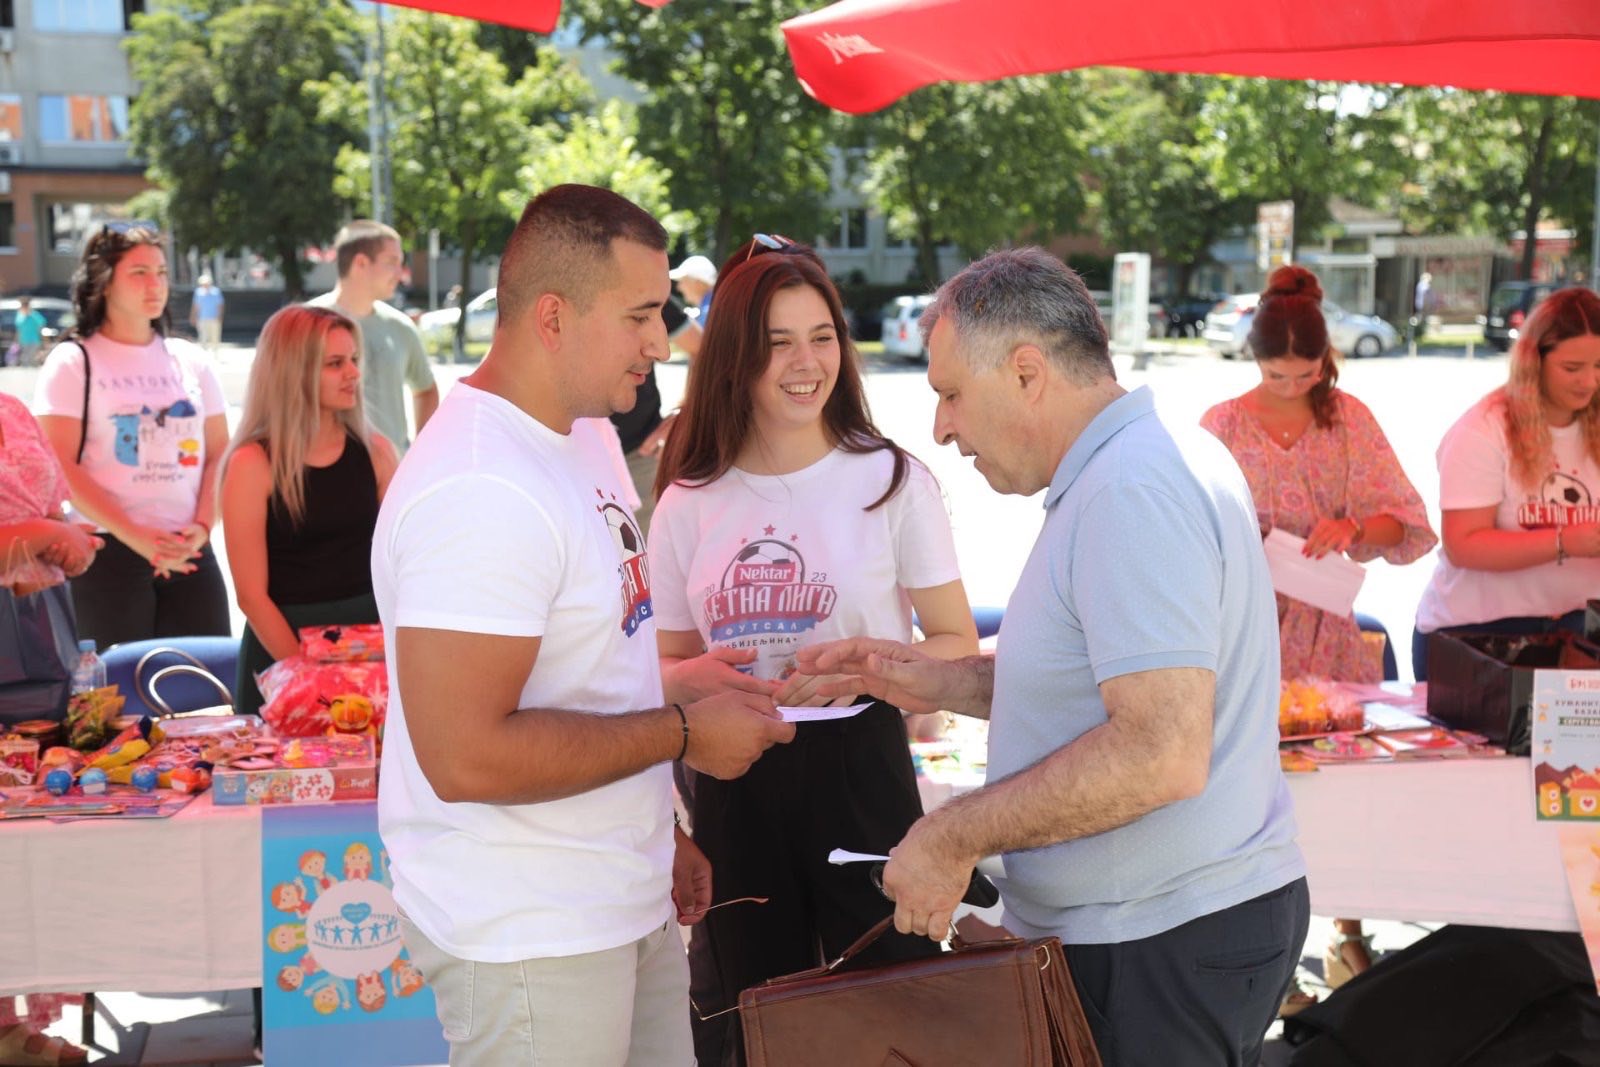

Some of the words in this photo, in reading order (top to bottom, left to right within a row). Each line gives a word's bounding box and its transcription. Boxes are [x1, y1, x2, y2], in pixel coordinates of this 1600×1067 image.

[739, 565, 792, 581] Nektar
[811, 571, 827, 583] 23
[778, 585, 834, 616] ЛИГА
[724, 621, 798, 636] ФУТСАЛ
